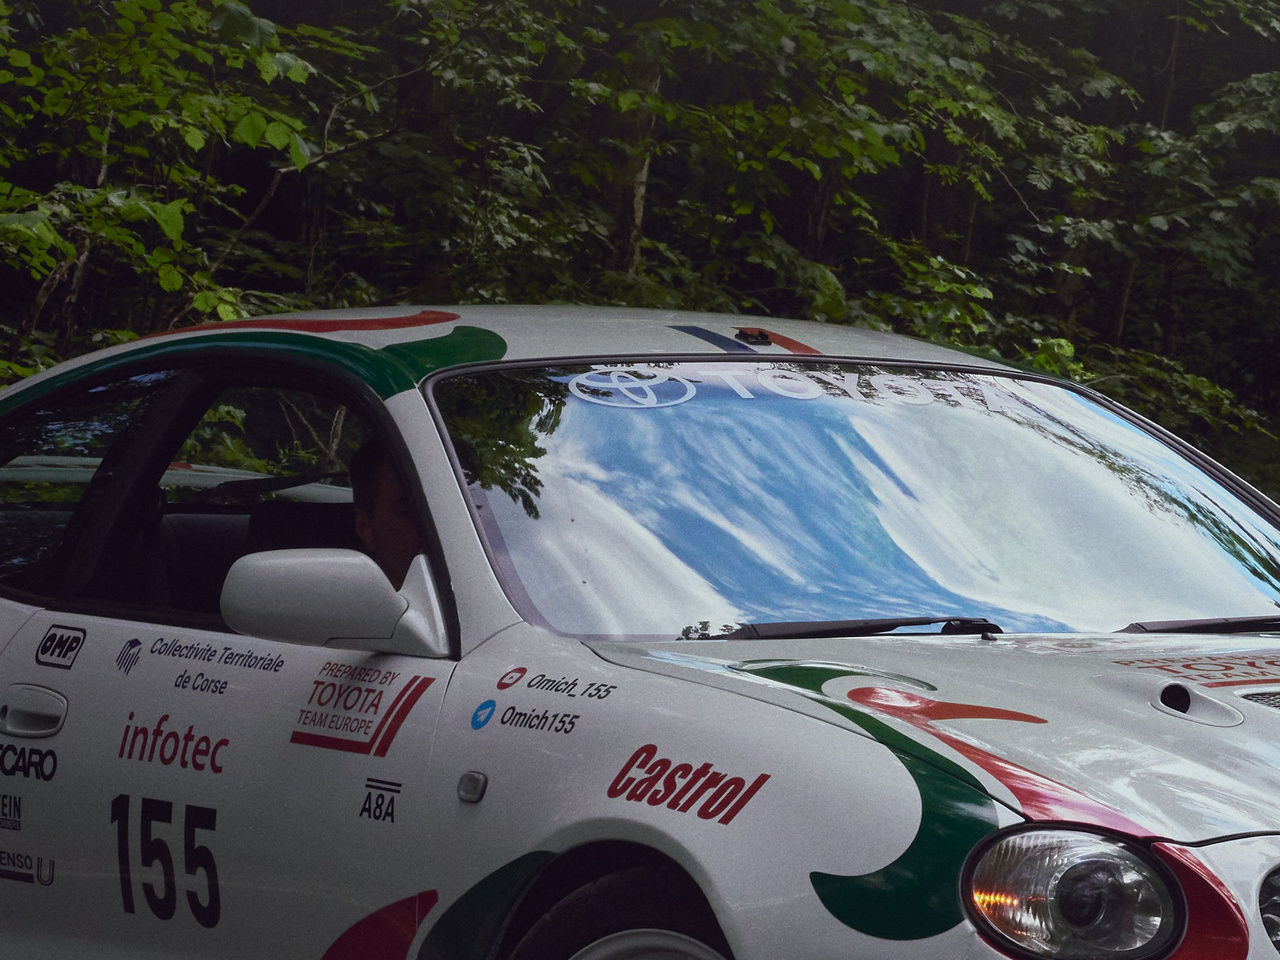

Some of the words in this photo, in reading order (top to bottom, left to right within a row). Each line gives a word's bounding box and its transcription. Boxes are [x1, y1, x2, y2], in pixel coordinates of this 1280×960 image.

[41, 632, 81, 659] OMP
[150, 638, 217, 664] Collectivite
[217, 647, 285, 673] Territoriale
[174, 669, 192, 688] de
[191, 672, 228, 695] Corse
[318, 662, 380, 683] PREPARED
[379, 671, 401, 686] BY
[1172, 670, 1280, 682] TEAM
[307, 680, 385, 715] TOYOTA
[297, 709, 328, 728] TEAM
[327, 714, 374, 736] EUROPE
[500, 706, 581, 734] Omich155
[118, 711, 230, 774] infotec
[0, 744, 57, 782] CARO
[607, 743, 772, 826] Castrol
[0, 794, 22, 819] EIN
[359, 791, 396, 824] A8A
[110, 793, 221, 929] 155
